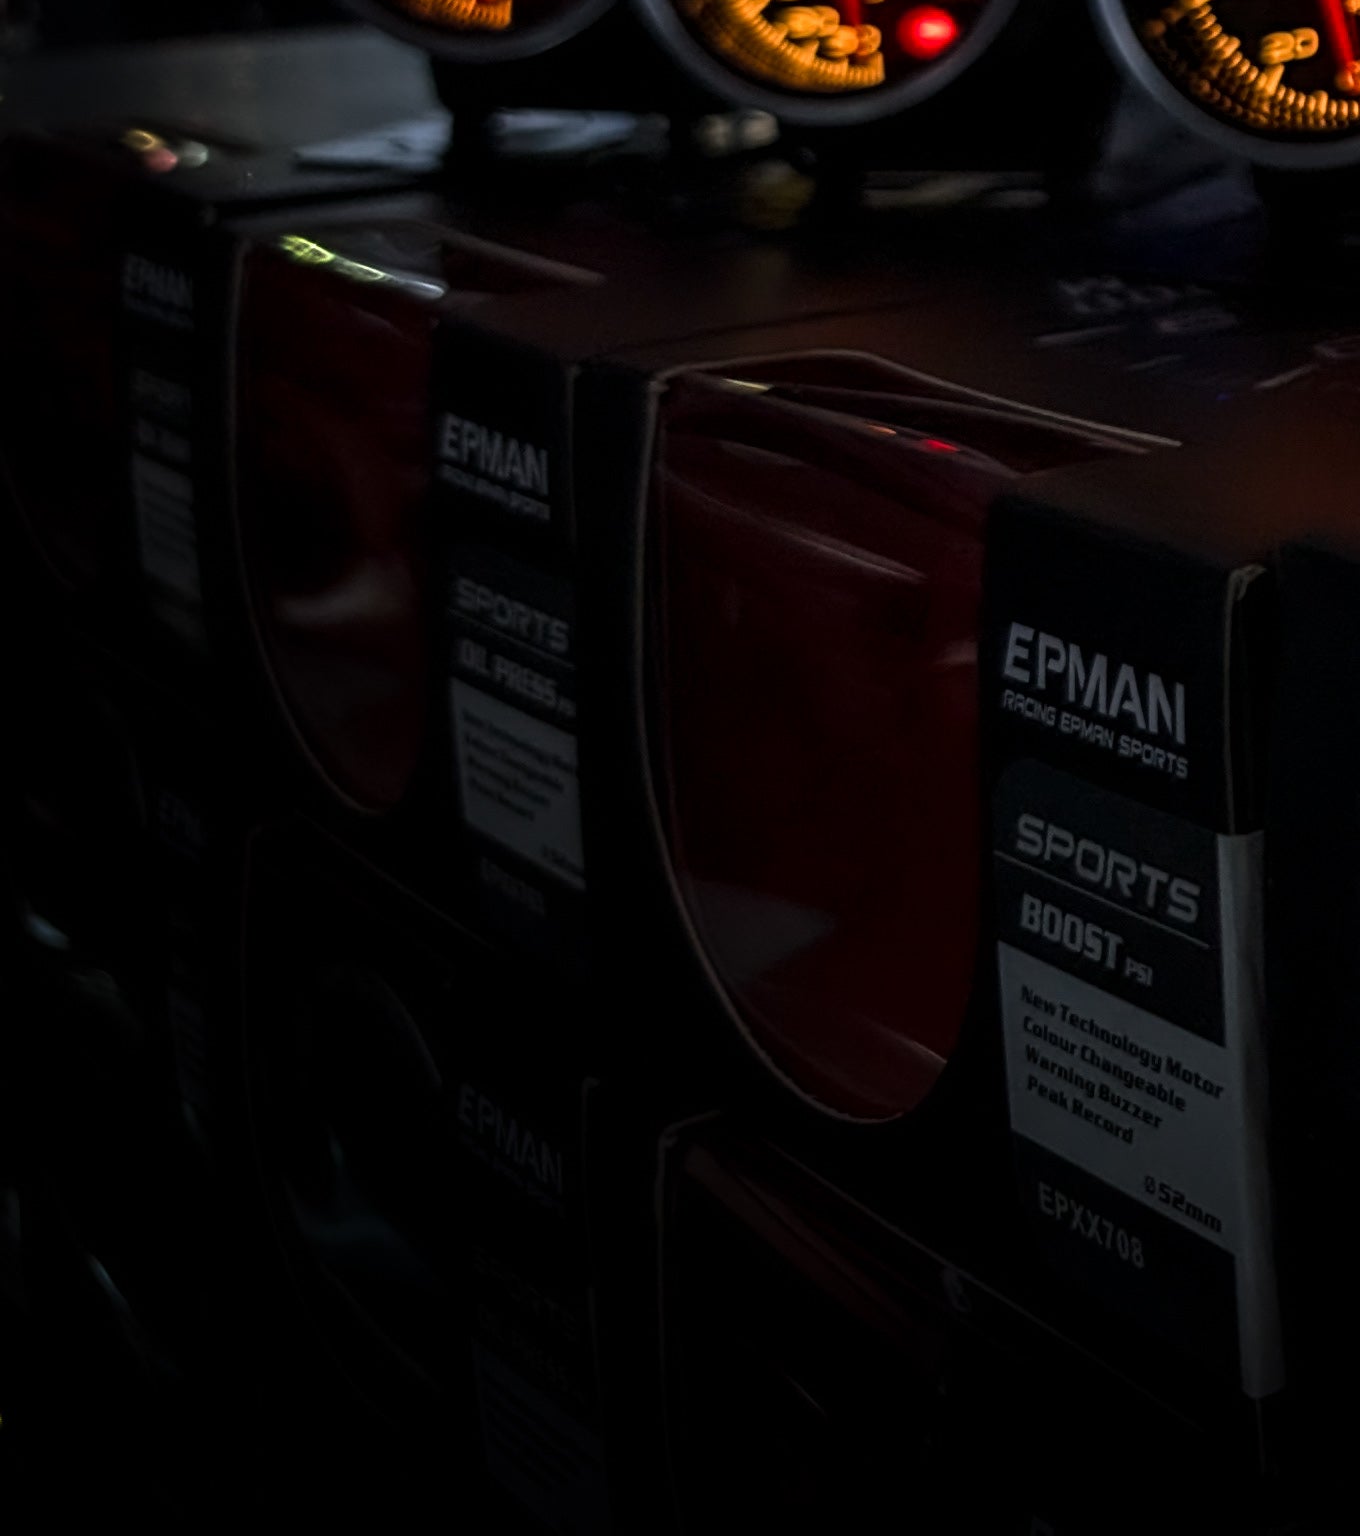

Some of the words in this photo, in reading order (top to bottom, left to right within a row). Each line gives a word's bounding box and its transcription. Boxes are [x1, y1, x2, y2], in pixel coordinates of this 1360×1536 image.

[439, 410, 549, 496] EPMAN
[455, 574, 571, 654] SPORTS
[1001, 620, 1187, 745] EPMAN
[1000, 688, 1057, 728] RACING
[1116, 734, 1189, 780] SPORTS
[1014, 813, 1201, 924] SPORTS
[1019, 891, 1124, 971] BOOST
[1020, 984, 1056, 1017] New
[1058, 1004, 1163, 1073] Technology
[1165, 1055, 1224, 1099] Motor
[1022, 1016, 1078, 1056] Colour
[1080, 1045, 1187, 1112] Changeable
[1025, 1044, 1096, 1098] Warning
[1097, 1084, 1164, 1130] Buzzer
[1027, 1074, 1069, 1109] Peak
[1071, 1098, 1135, 1145] Record
[1036, 1179, 1146, 1271] EPXX708
